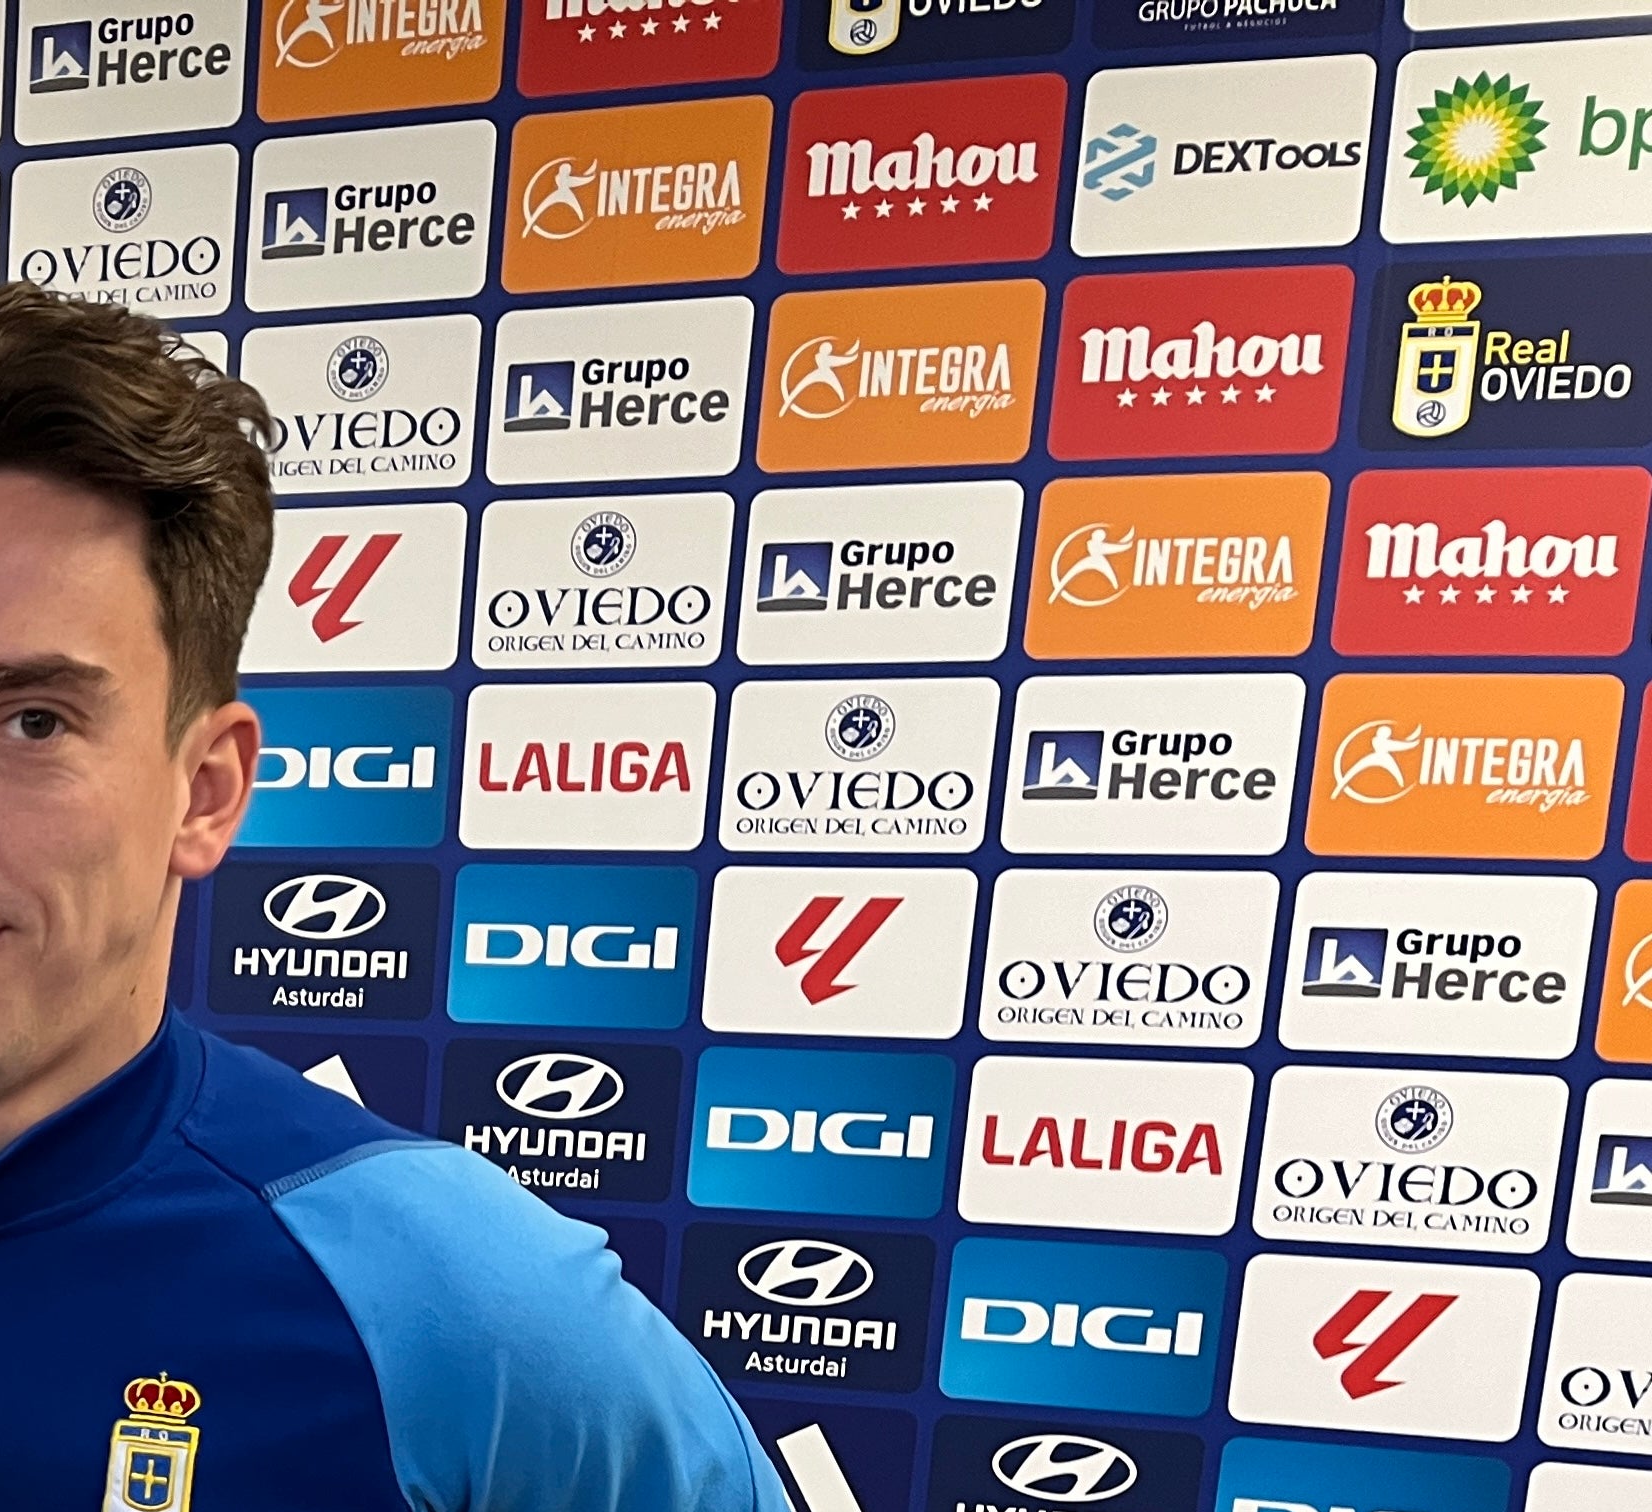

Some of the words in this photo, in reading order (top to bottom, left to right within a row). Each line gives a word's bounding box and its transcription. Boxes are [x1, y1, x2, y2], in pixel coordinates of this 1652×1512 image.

[99, 14, 193, 45] Grupo
[347, 0, 481, 44] INTEGRA
[1139, 0, 1218, 22] GRUPO
[98, 44, 230, 87] Herce
[807, 133, 1038, 196] Mahou
[335, 182, 436, 213] Grupo
[598, 161, 740, 217] INTEGRA
[334, 213, 474, 254] Herce
[20, 236, 220, 286] OVIEDO
[136, 283, 216, 302] CAMINO
[1081, 322, 1323, 382] Mahou
[1485, 330, 1569, 365] Real
[582, 358, 689, 388] Grupo
[859, 344, 1010, 397] INTEGRA
[1482, 365, 1631, 401] OVIEDO
[580, 390, 729, 428] Herce
[266, 407, 461, 452] OVIEDO
[330, 458, 361, 474] DEL
[371, 454, 455, 472] CAMINO
[841, 541, 955, 571] Grupo
[1134, 536, 1292, 587] INTEGRA
[1366, 520, 1618, 578] Mahou
[489, 585, 710, 628] OVIEDO
[837, 573, 996, 610] Herce
[489, 635, 564, 651] ORIGEN
[573, 634, 605, 650] DEL
[615, 632, 704, 649] CAMINO
[1112, 730, 1232, 762] Grupo
[1420, 738, 1584, 786] INTEGRA
[251, 746, 435, 789] DIGI
[480, 742, 690, 792] LALIGA
[1108, 763, 1276, 800] Herce
[737, 771, 973, 811] OVIEDO
[737, 818, 816, 834] ORIGEN
[826, 819, 864, 836] DEL
[872, 818, 966, 834] CAMINO
[235, 948, 407, 978] HYUNDAI
[466, 924, 678, 969] DIGI
[1397, 929, 1521, 963] Grupo
[273, 987, 363, 1007] Asturdai
[999, 961, 1250, 1005] OVIEDO
[1392, 962, 1566, 1004] Herce
[998, 1007, 1083, 1024] ORIGEN
[1093, 1009, 1129, 1026] DEL
[1142, 1011, 1242, 1029] CAMINO
[460, 1126, 645, 1166] HYUNDAI
[707, 1107, 933, 1158] DIGI
[982, 1115, 1222, 1175] LALIGA
[507, 1166, 599, 1190] Asturdai
[1275, 1159, 1537, 1209] OVIEDO
[1273, 1206, 1364, 1225] ORIGEN
[1373, 1210, 1412, 1228] DEL
[1424, 1214, 1529, 1234] CAMINO
[704, 1310, 896, 1350] HYUNDAI
[961, 1298, 1203, 1355] DIGI
[745, 1352, 846, 1377] Asturdai
